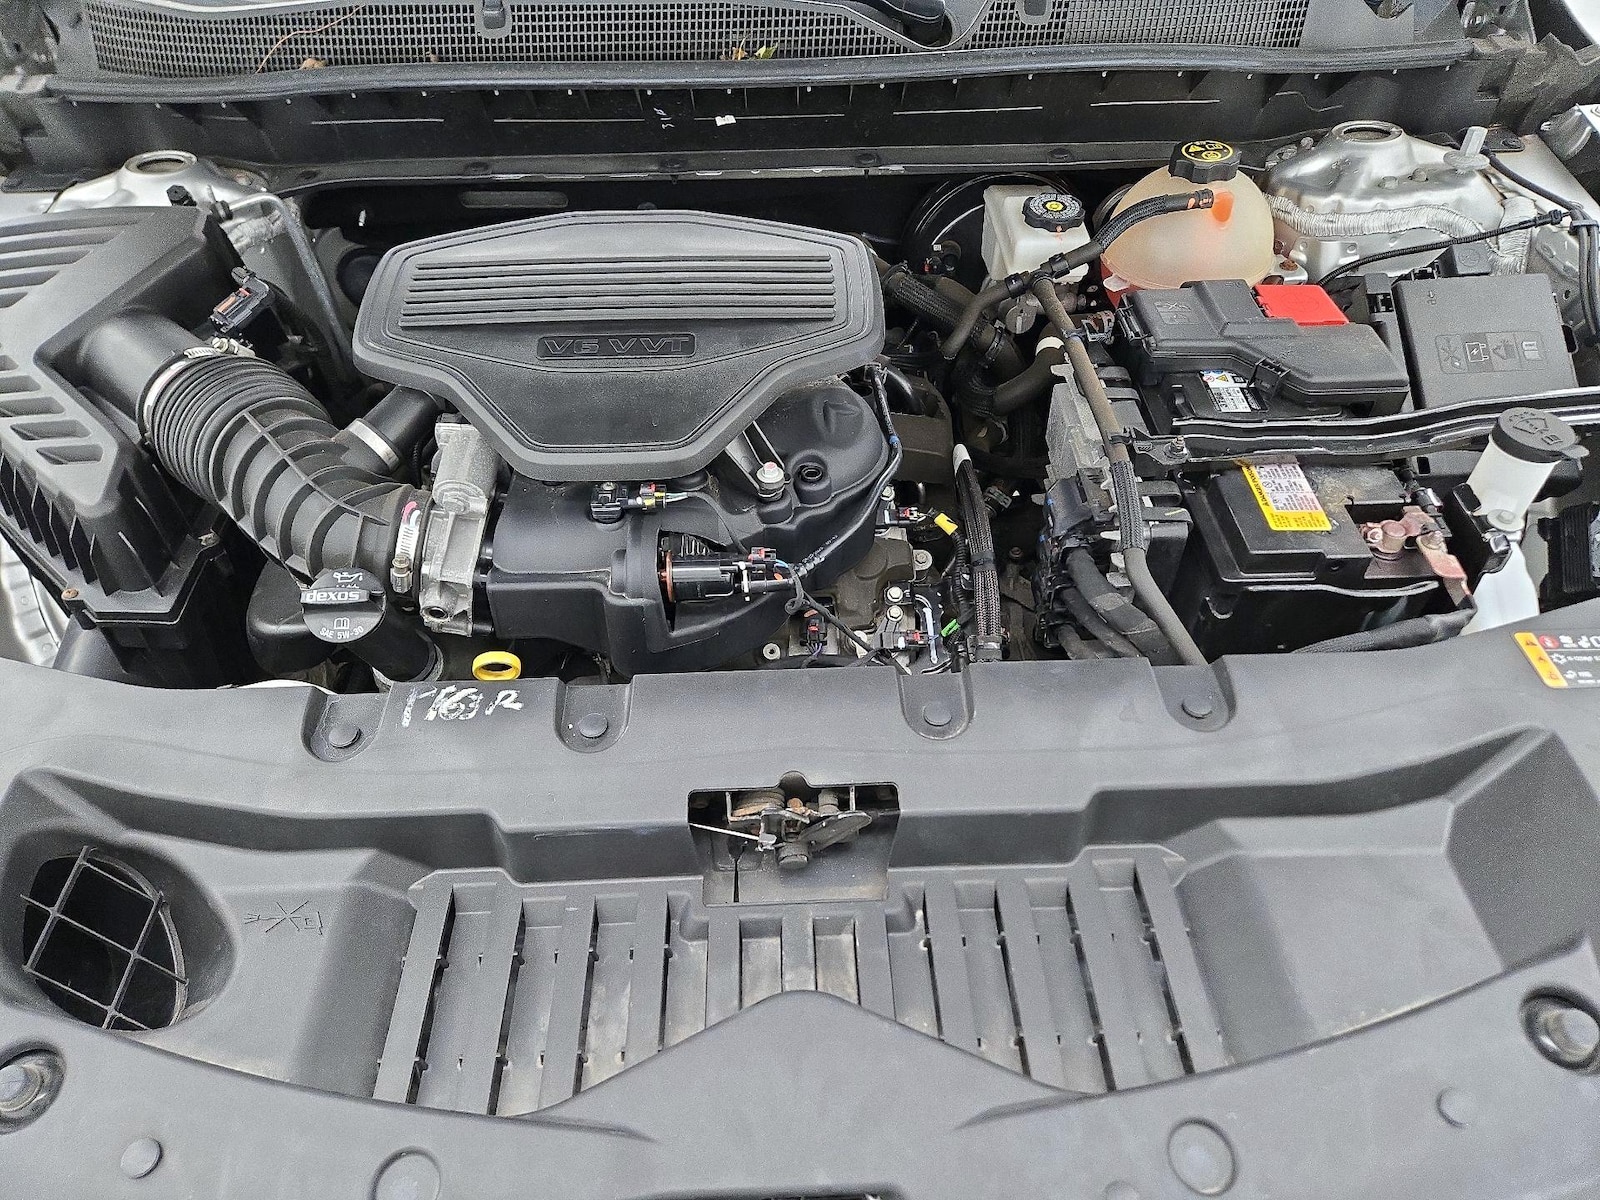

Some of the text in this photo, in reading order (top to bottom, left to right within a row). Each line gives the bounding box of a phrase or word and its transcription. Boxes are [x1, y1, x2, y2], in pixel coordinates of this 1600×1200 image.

[545, 337, 689, 354] V6 VVT
[305, 590, 360, 601] dexos
[319, 625, 364, 640] SAE 5W-30
